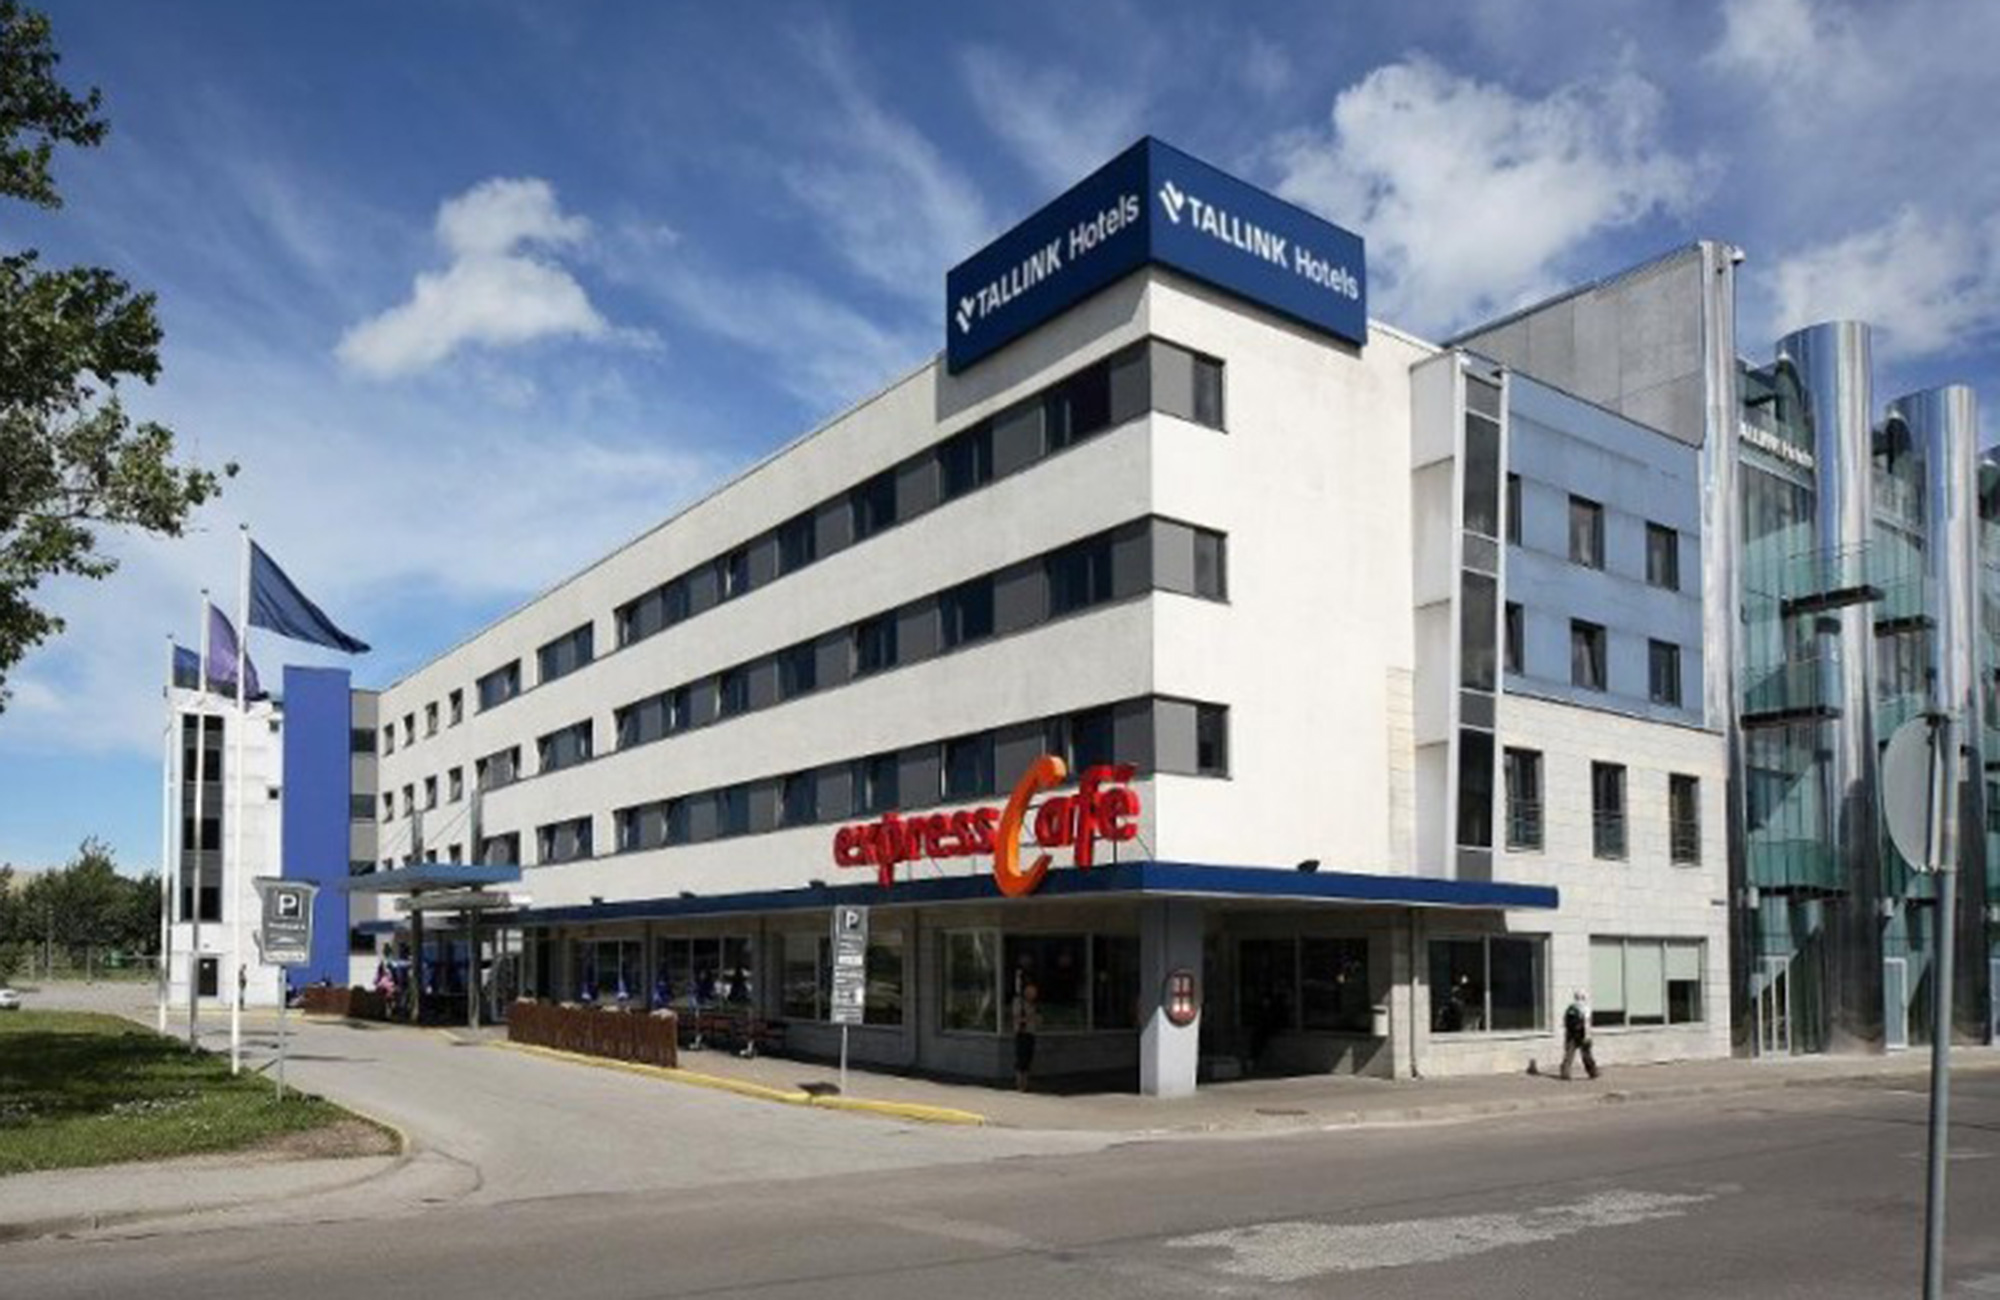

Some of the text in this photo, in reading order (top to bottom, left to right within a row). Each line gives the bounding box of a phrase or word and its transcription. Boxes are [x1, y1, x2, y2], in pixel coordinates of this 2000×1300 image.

[977, 194, 1139, 318] TALLINK Hotels
[1188, 196, 1359, 300] TALLINK Hotels
[279, 894, 297, 915] P
[846, 910, 859, 929] P
